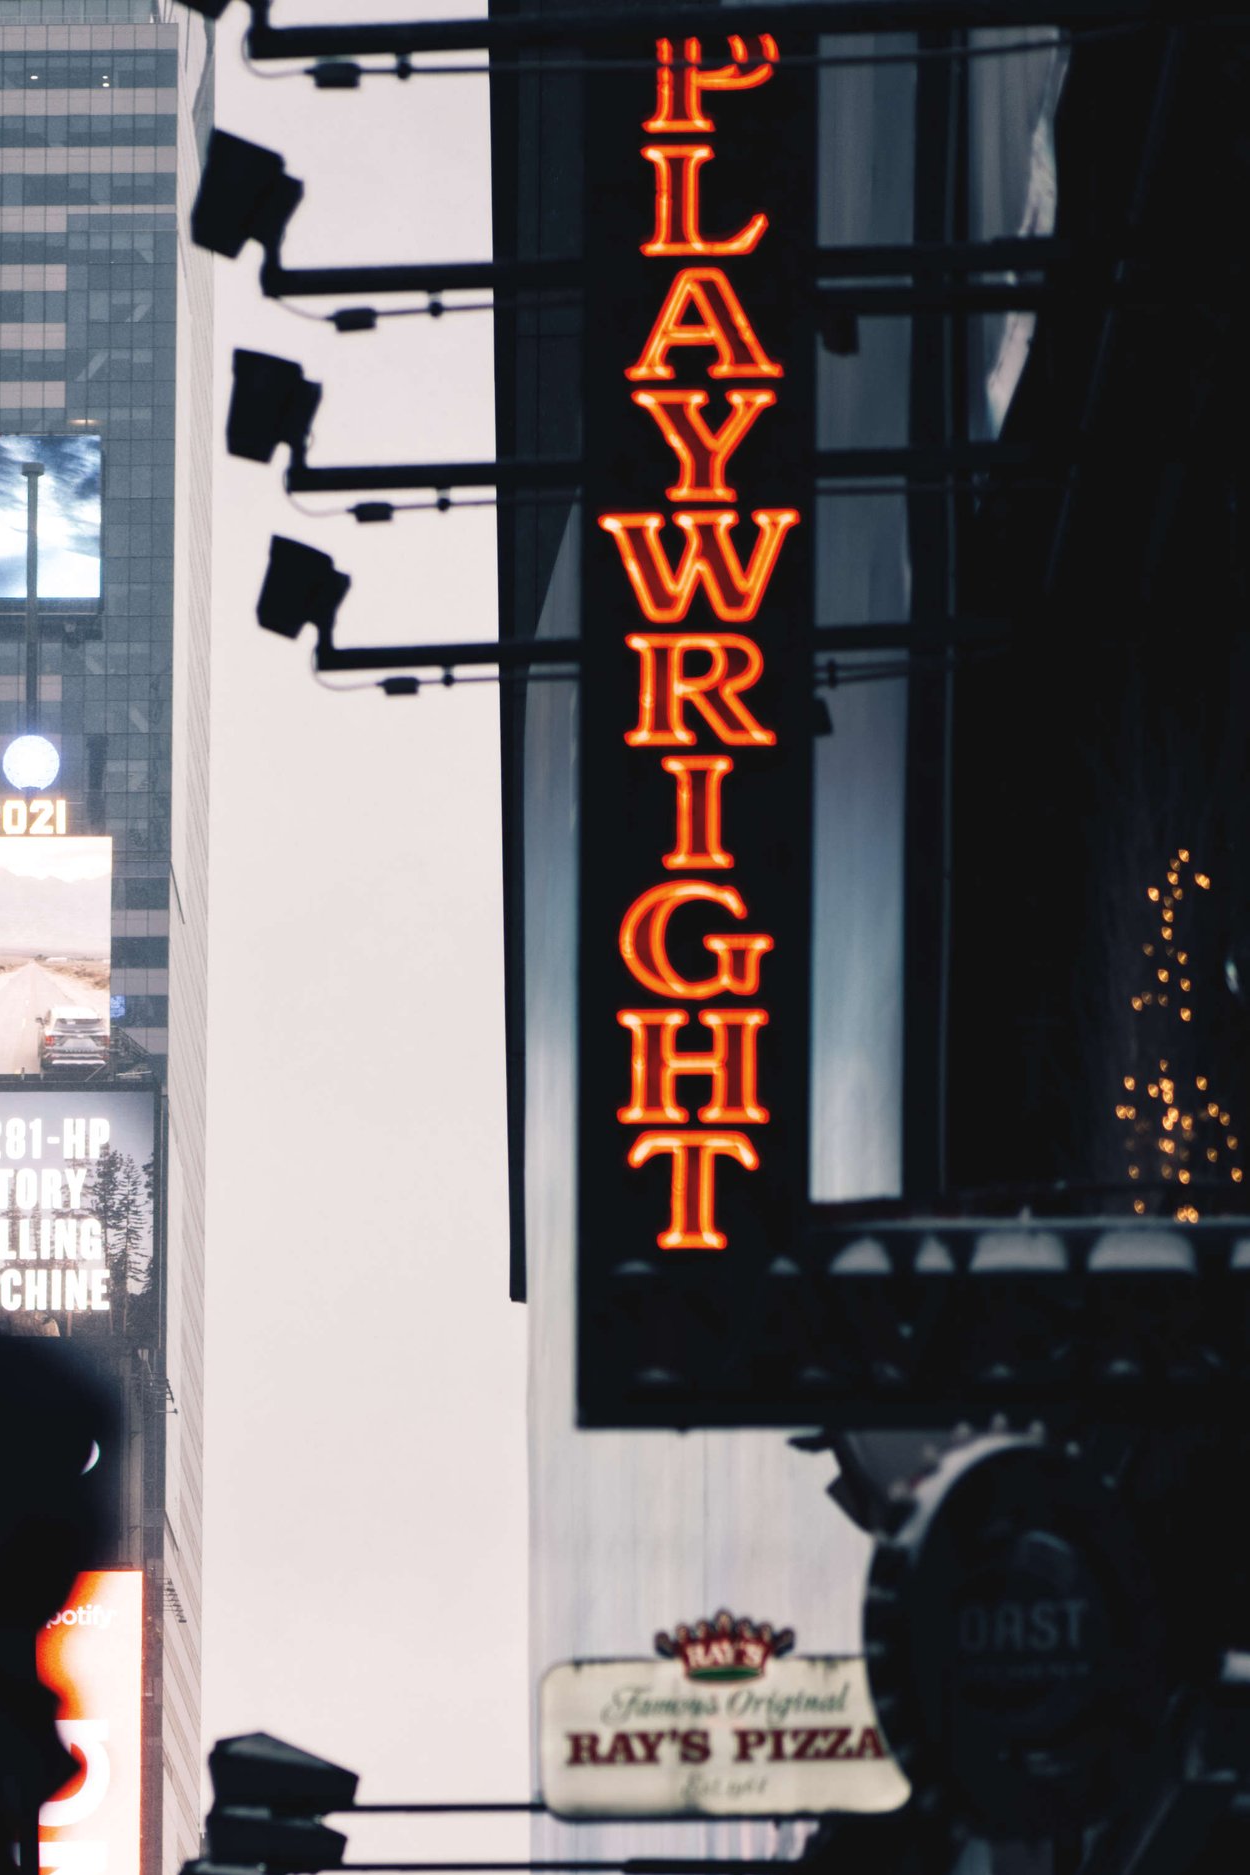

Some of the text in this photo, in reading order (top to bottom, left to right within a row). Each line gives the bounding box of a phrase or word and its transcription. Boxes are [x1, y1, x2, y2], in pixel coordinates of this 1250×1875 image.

[598, 32, 801, 1250] PLAYWRIGHT
[685, 1641, 764, 1667] RAY'S
[600, 1681, 851, 1725] Famous Original
[566, 1726, 886, 1767] RAY'S PIZZA
